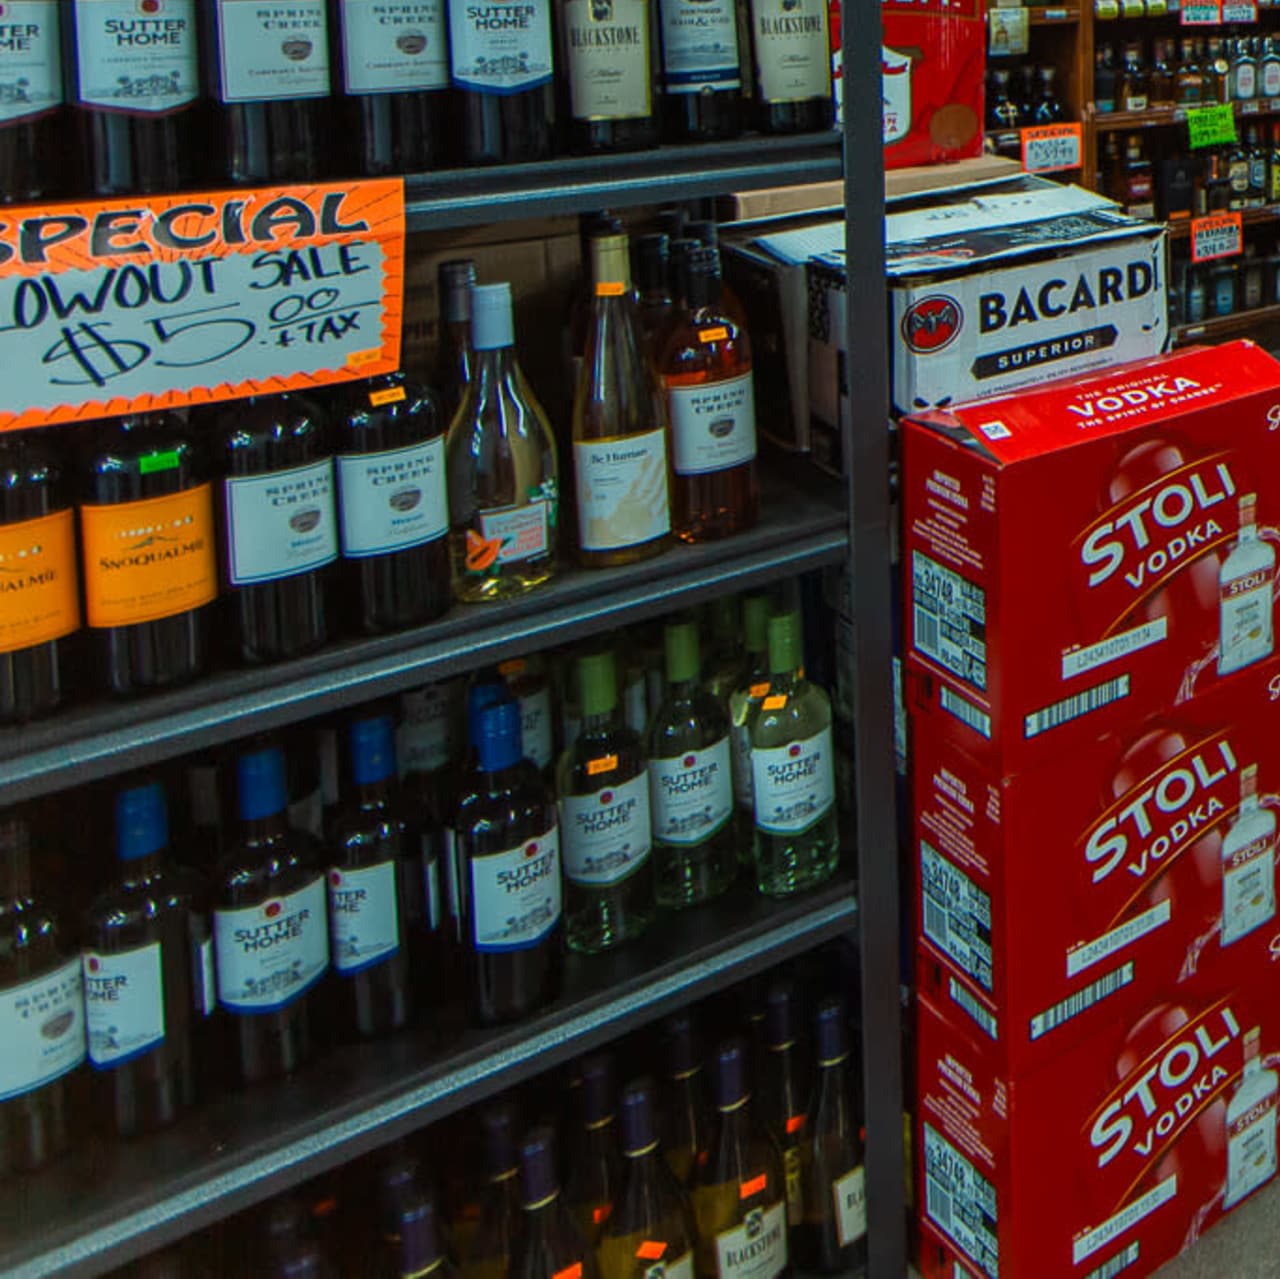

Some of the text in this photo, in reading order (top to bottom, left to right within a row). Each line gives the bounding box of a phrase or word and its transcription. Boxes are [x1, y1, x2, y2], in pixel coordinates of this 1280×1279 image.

[105, 18, 187, 33] SUTTER
[467, 5, 536, 18] SUTTER
[475, 18, 530, 30] HOME
[760, 15, 823, 36] BLACKSTONE
[117, 33, 182, 46] HOME
[572, 25, 641, 47] BLACKSTONE
[0, 192, 370, 266] PECIAL
[12, 240, 371, 331] OWOUT SALE
[998, 334, 1096, 369] SUPERIOR
[1067, 376, 1201, 418] VODKA
[1081, 463, 1236, 588] STOLI
[1125, 519, 1222, 589] VODKA
[1229, 572, 1266, 595] STOLI
[660, 762, 719, 787] SUTTER
[766, 752, 821, 778] SUTTER
[773, 766, 817, 786] HOME
[668, 776, 714, 797] HOME
[575, 797, 637, 824] SUTTER
[584, 814, 631, 835] HOME
[1085, 741, 1237, 884] STOLI
[1128, 797, 1224, 877] VODKA
[1231, 838, 1268, 867] STOLI
[496, 849, 556, 887] SUTTER
[506, 866, 554, 894] HOME
[233, 909, 310, 943] SUTTER
[243, 925, 303, 953] HOME
[1090, 1007, 1240, 1168] STOLI
[1134, 1065, 1228, 1156] VODKA
[1235, 1099, 1270, 1133] STOLI
